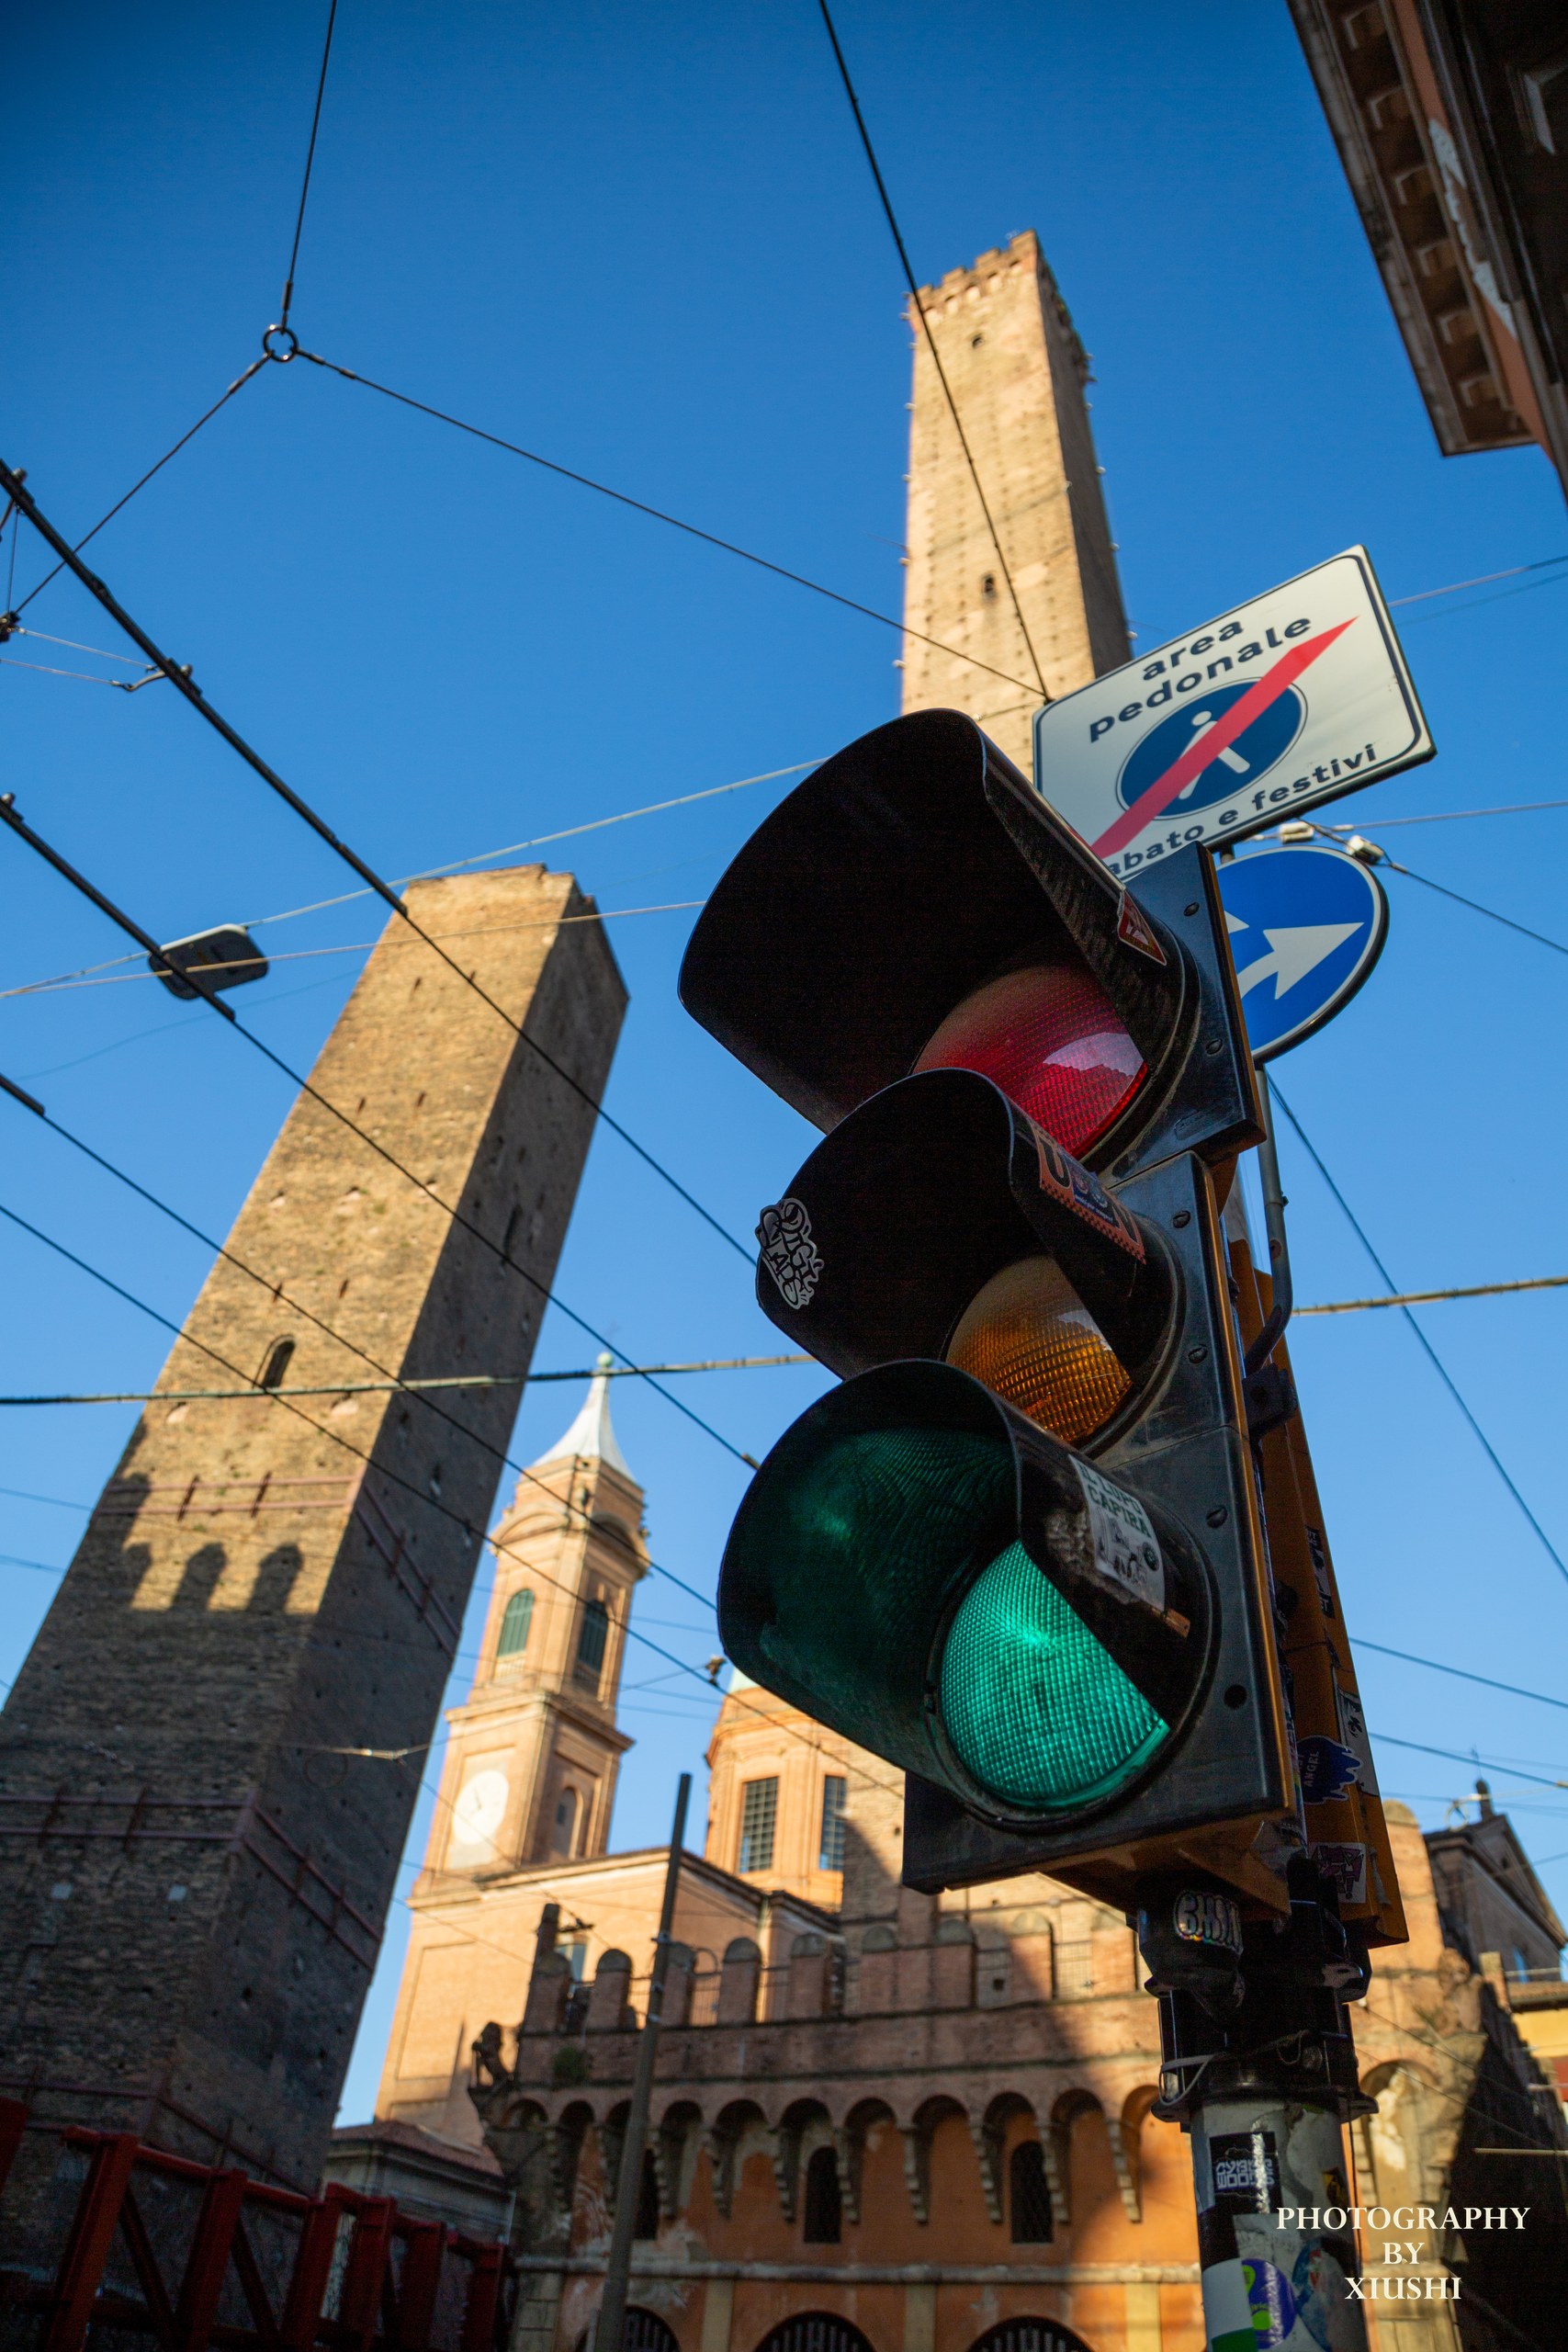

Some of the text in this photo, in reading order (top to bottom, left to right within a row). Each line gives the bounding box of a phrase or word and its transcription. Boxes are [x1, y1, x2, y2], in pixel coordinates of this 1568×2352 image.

[1089, 617, 1312, 742] pedonale
[1143, 620, 1244, 681] area
[1219, 808, 1239, 826] e
[1251, 744, 1377, 810] festivi
